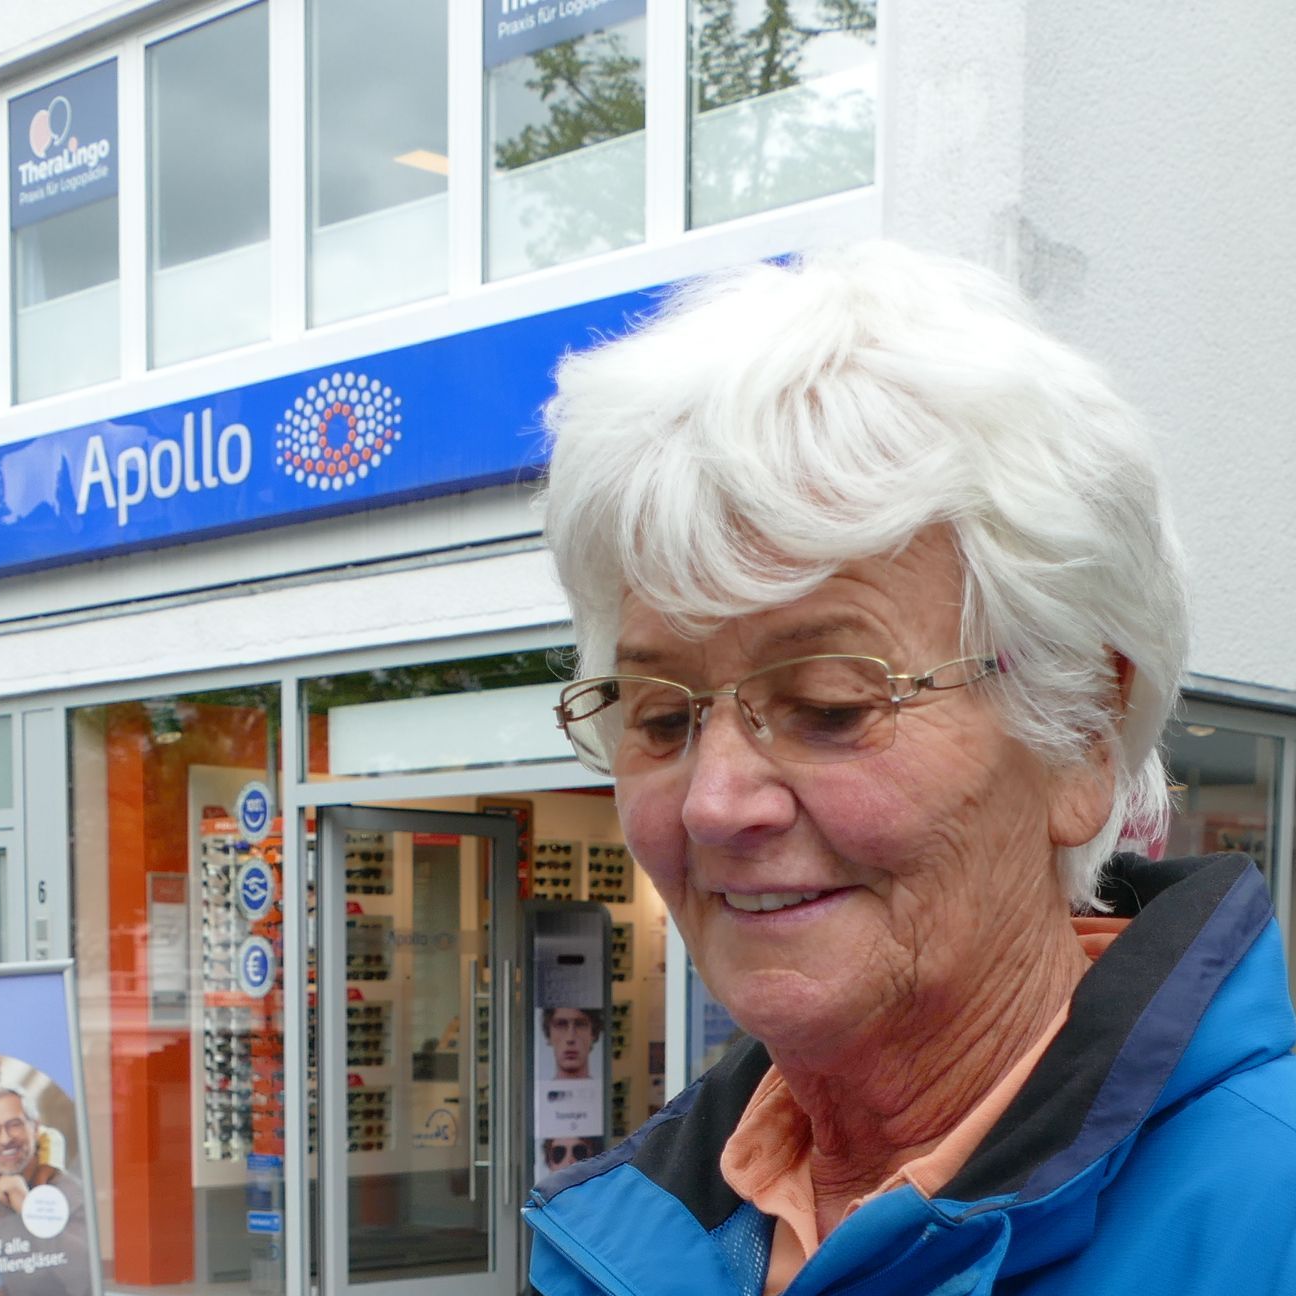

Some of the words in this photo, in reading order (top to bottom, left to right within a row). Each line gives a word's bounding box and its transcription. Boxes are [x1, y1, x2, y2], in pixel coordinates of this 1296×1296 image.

[497, 13, 536, 39] Praxis
[537, 5, 557, 25] für
[18, 137, 110, 186] TheraLingo
[75, 405, 253, 526] Apollo
[38, 880, 47, 904] 6
[4, 1236, 31, 1255] alle
